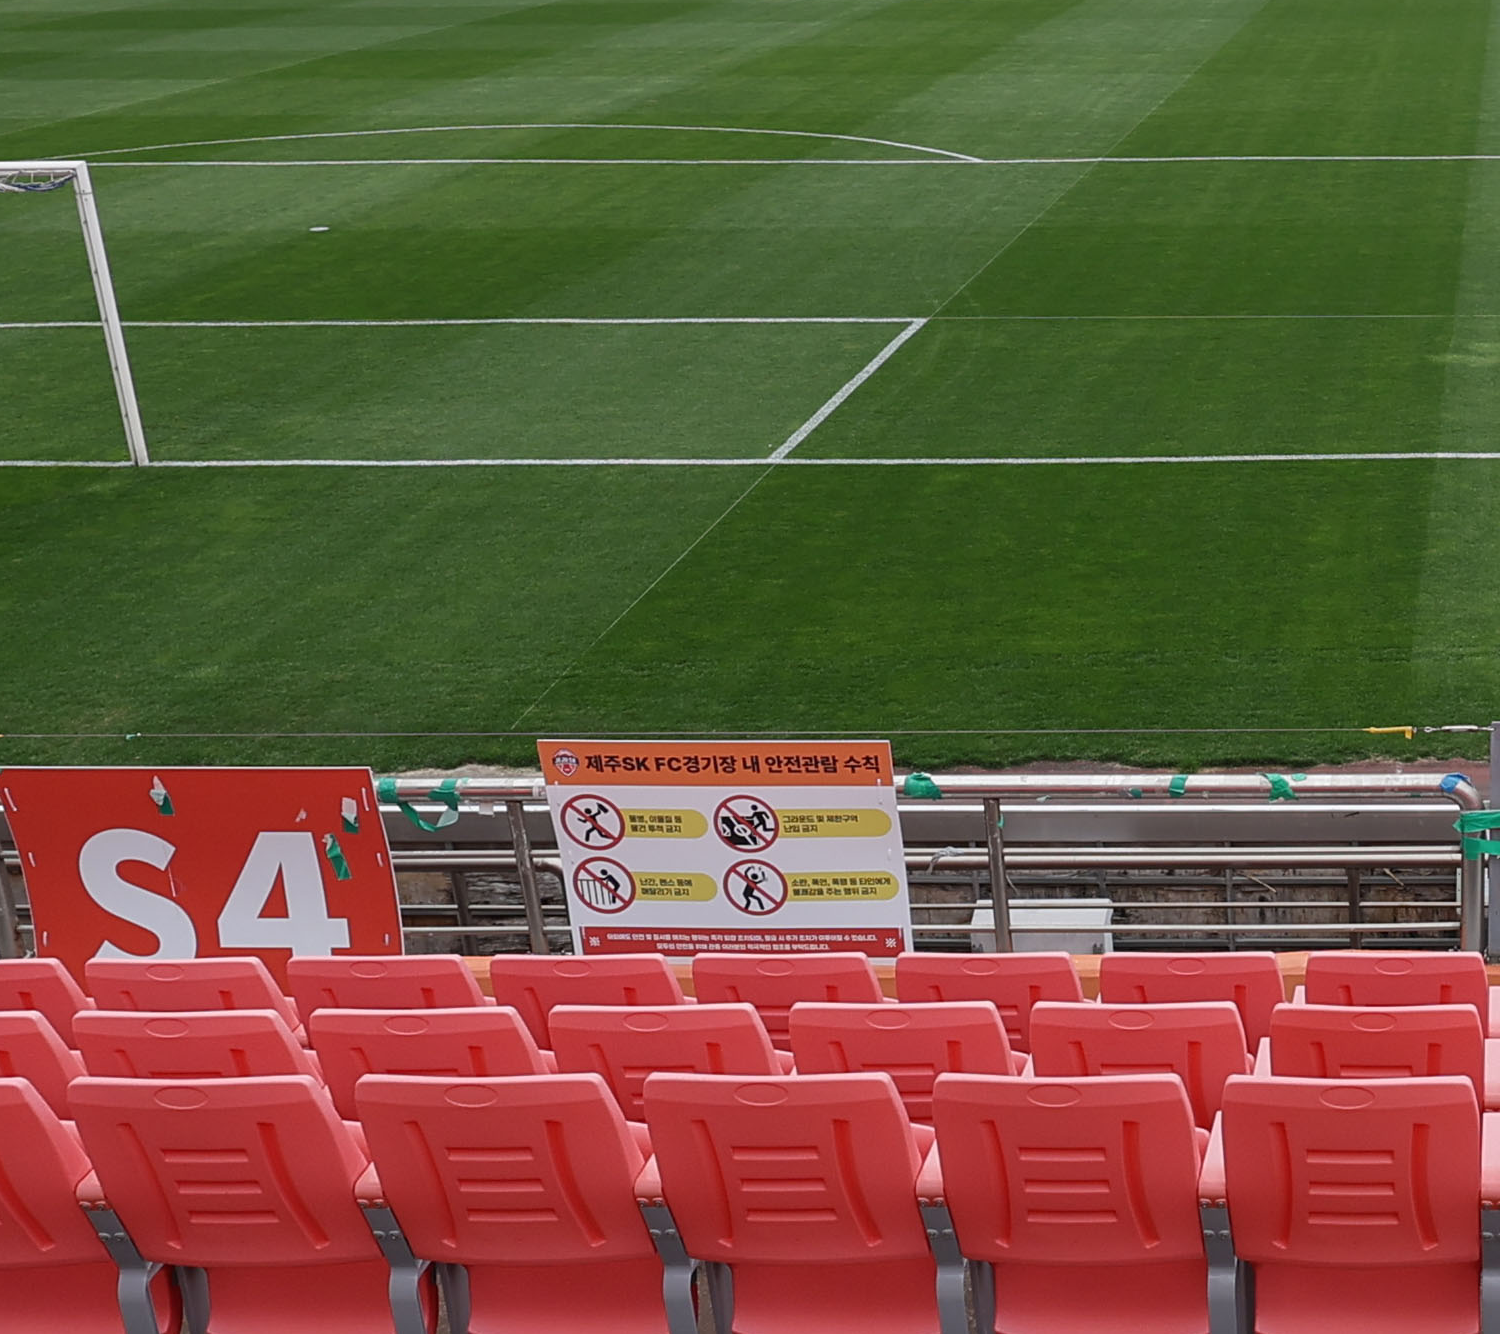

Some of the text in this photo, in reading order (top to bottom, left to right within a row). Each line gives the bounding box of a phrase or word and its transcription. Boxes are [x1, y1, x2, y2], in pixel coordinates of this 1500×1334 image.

[586, 754, 881, 774] 제주SK FC경기장 내 안전관람 수칙
[78, 828, 348, 959] S4
